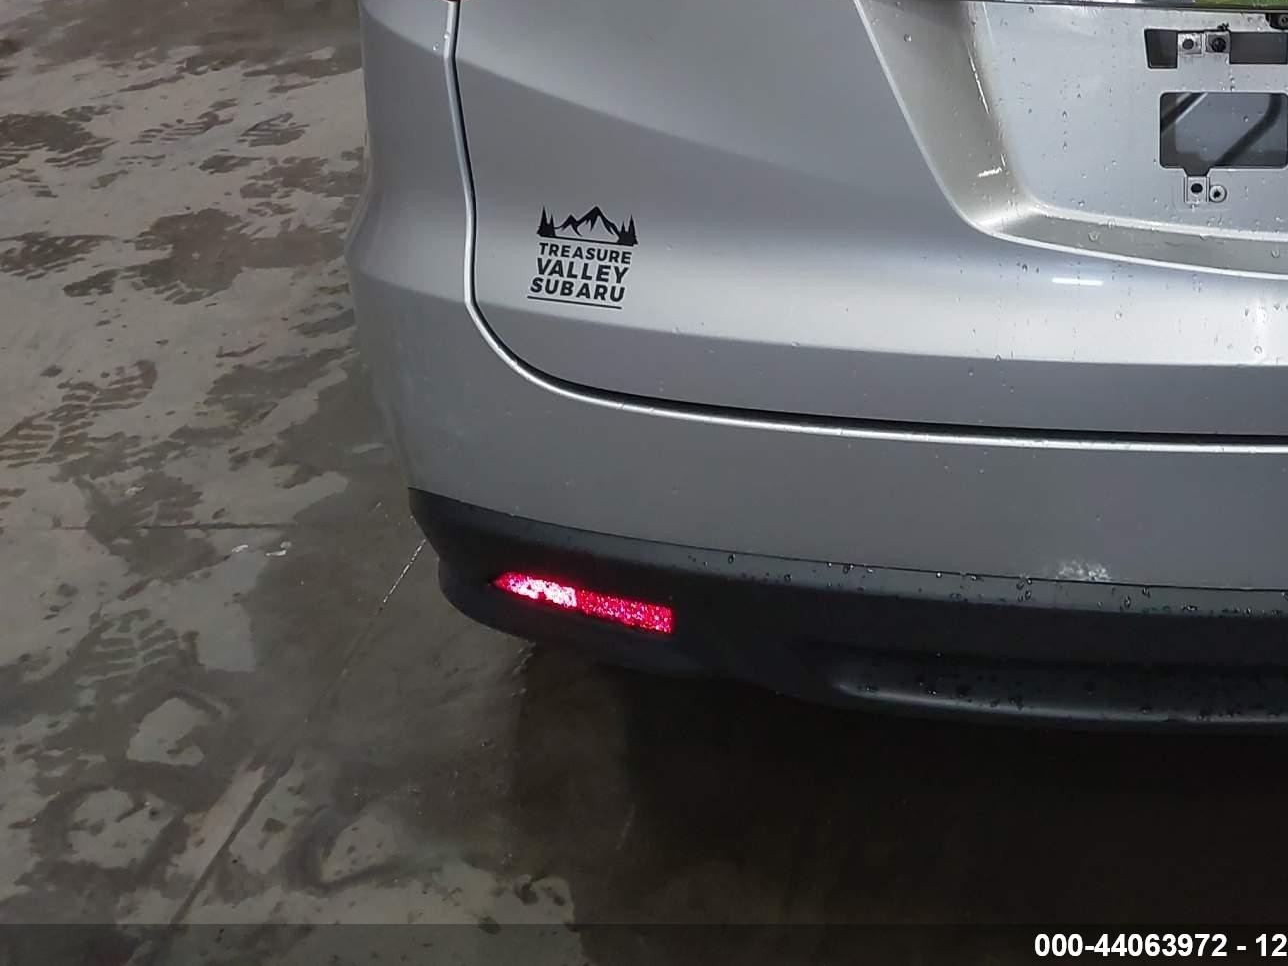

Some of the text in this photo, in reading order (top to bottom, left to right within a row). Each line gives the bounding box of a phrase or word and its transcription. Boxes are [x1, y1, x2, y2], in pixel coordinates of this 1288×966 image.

[538, 242, 633, 265] TREASURE
[536, 257, 630, 284] VALLEY
[529, 277, 626, 303] SUBARU
